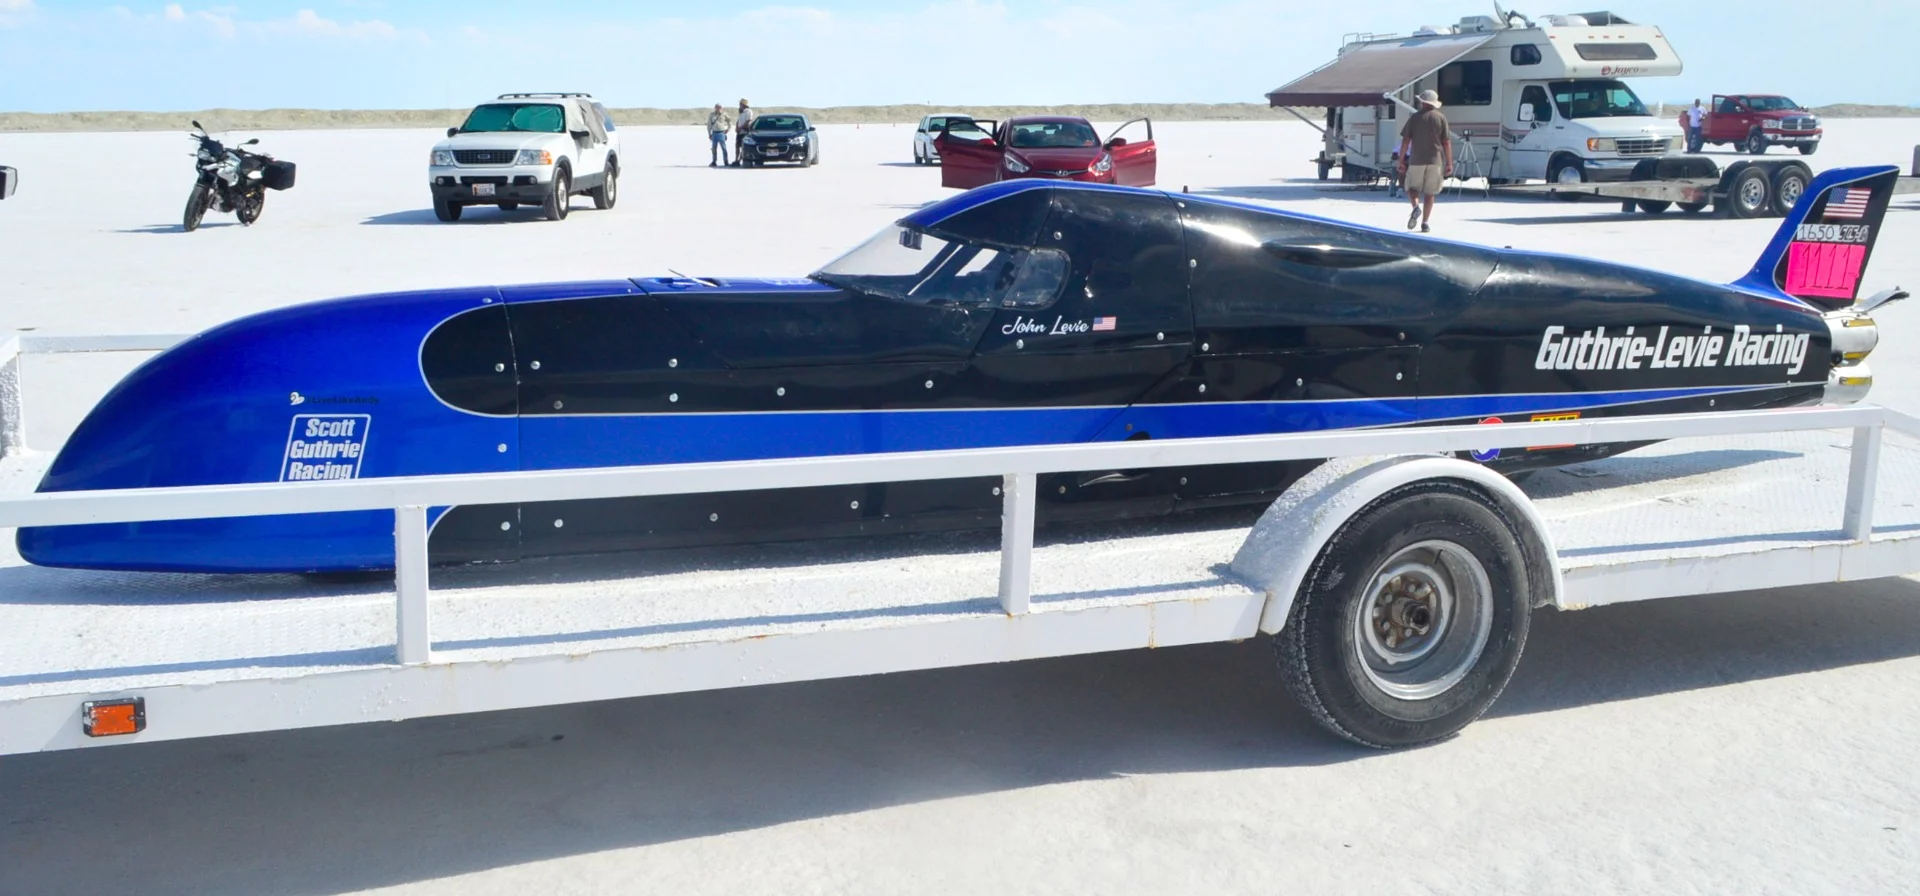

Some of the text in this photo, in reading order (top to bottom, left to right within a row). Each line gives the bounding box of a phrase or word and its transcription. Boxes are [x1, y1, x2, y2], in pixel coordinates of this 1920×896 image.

[1611, 66, 1639, 75] Jayco
[1799, 224, 1835, 240] 1650
[1002, 315, 1089, 335] John Levie
[1535, 324, 1810, 375] Guthrie-Levie Racing
[305, 418, 356, 437] Scott
[290, 440, 361, 459] Guthrie
[288, 462, 353, 480] Racing
